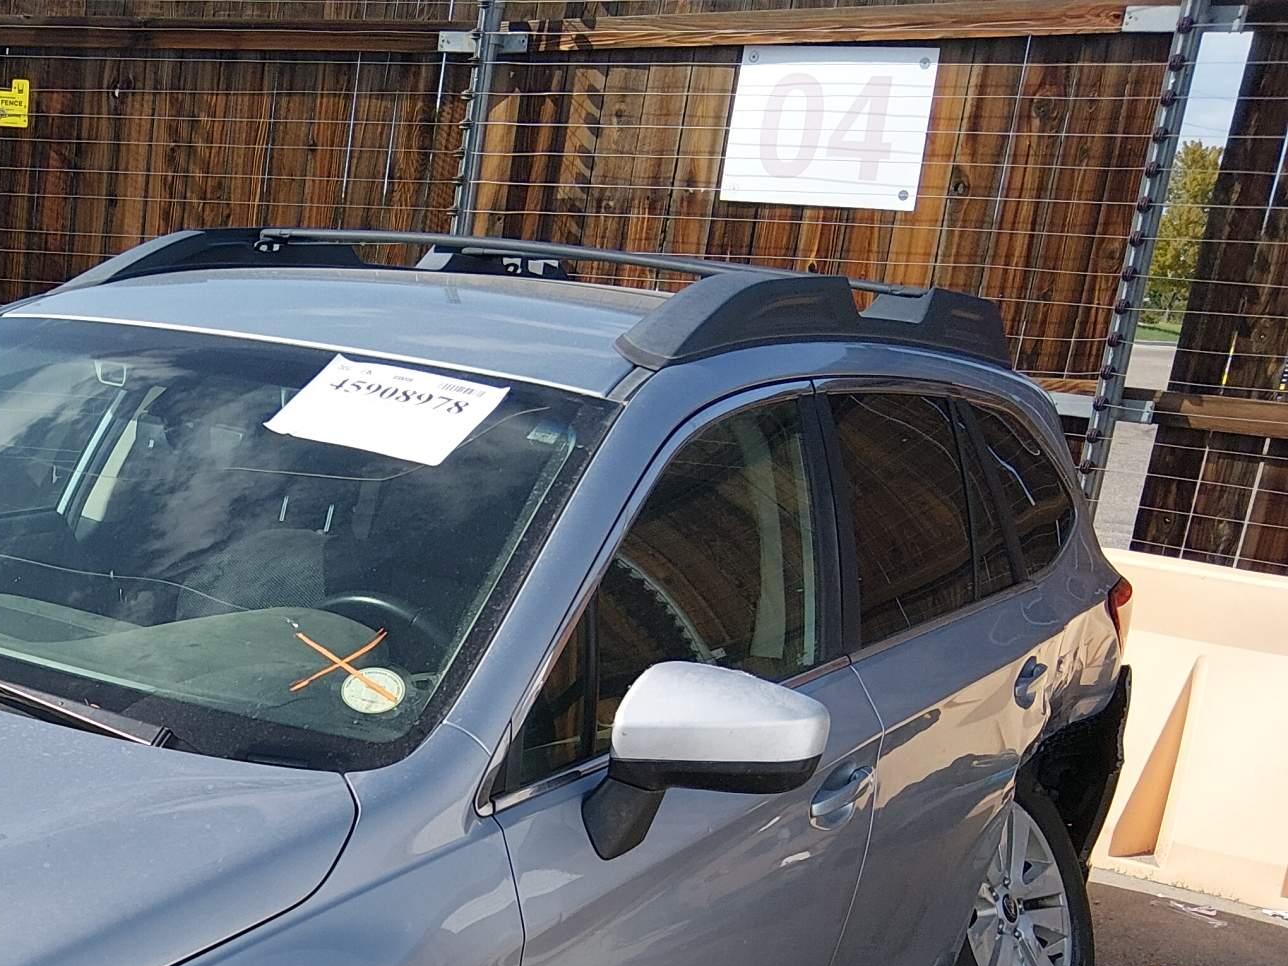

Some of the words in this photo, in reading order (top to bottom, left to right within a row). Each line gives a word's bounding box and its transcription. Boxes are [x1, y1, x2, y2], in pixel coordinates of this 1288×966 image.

[1, 99, 23, 107] FENCE
[759, 72, 893, 181] 04
[329, 377, 470, 415] 45908978
